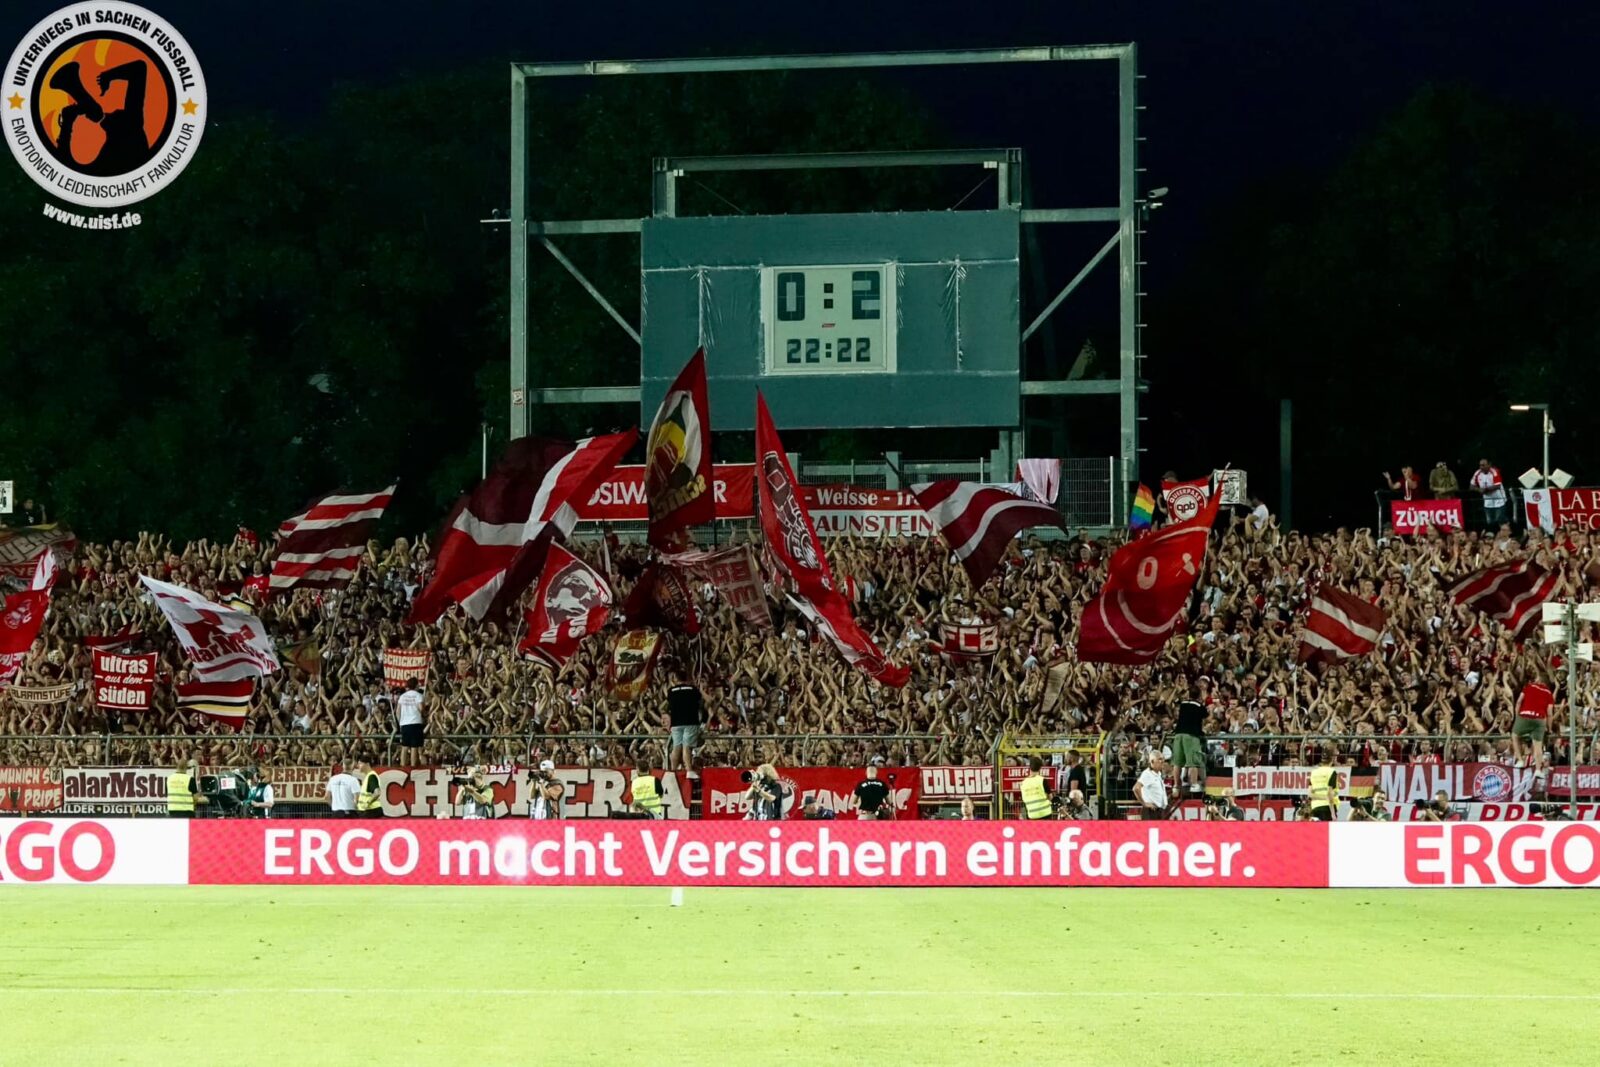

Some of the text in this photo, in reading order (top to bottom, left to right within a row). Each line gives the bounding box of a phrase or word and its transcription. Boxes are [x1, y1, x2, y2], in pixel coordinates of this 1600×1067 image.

[787, 338, 870, 363] 22:22
[816, 488, 878, 506] Weisse
[813, 515, 934, 532] AUNSTEIN
[1396, 507, 1459, 526] ZÜRICH
[100, 655, 149, 674] ultras
[98, 685, 146, 705] süden
[922, 768, 993, 795] COLEGIO
[1237, 771, 1267, 789] RED
[1381, 764, 1464, 803] MAHL
[24, 787, 62, 807] PRIDE
[291, 783, 326, 798] UNS
[0, 821, 116, 882] GO
[264, 826, 1256, 877] ERGO macht Versichern einfacher.
[1404, 823, 1600, 885] ERGO
